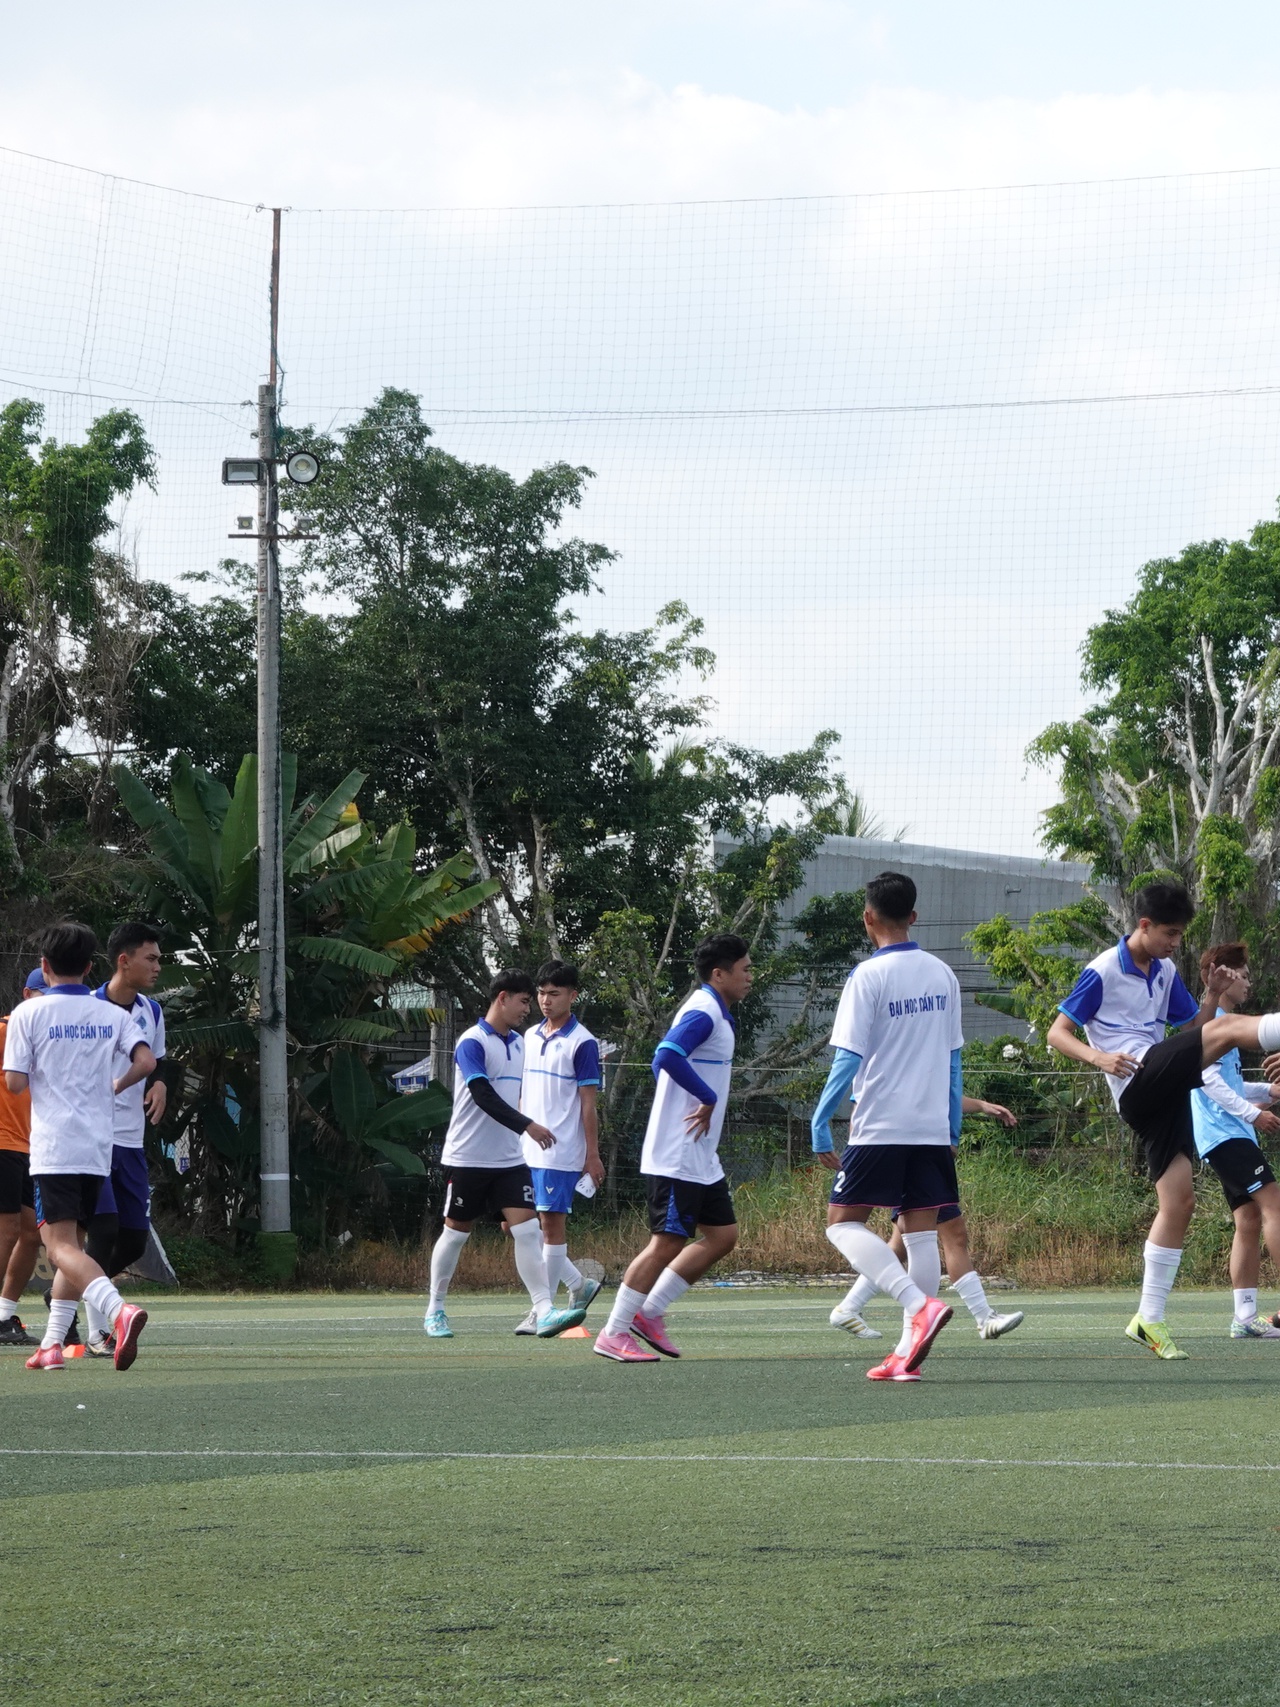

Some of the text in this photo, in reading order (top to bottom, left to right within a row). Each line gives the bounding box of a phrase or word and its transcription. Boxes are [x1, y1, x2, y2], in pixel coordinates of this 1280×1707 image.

[888, 1000, 902, 1019] ĐẠI
[49, 1025, 63, 1042] ĐẠI
[64, 1024, 80, 1042] HỌC
[98, 1023, 113, 1039] THƠ
[834, 1171, 846, 1193] 2
